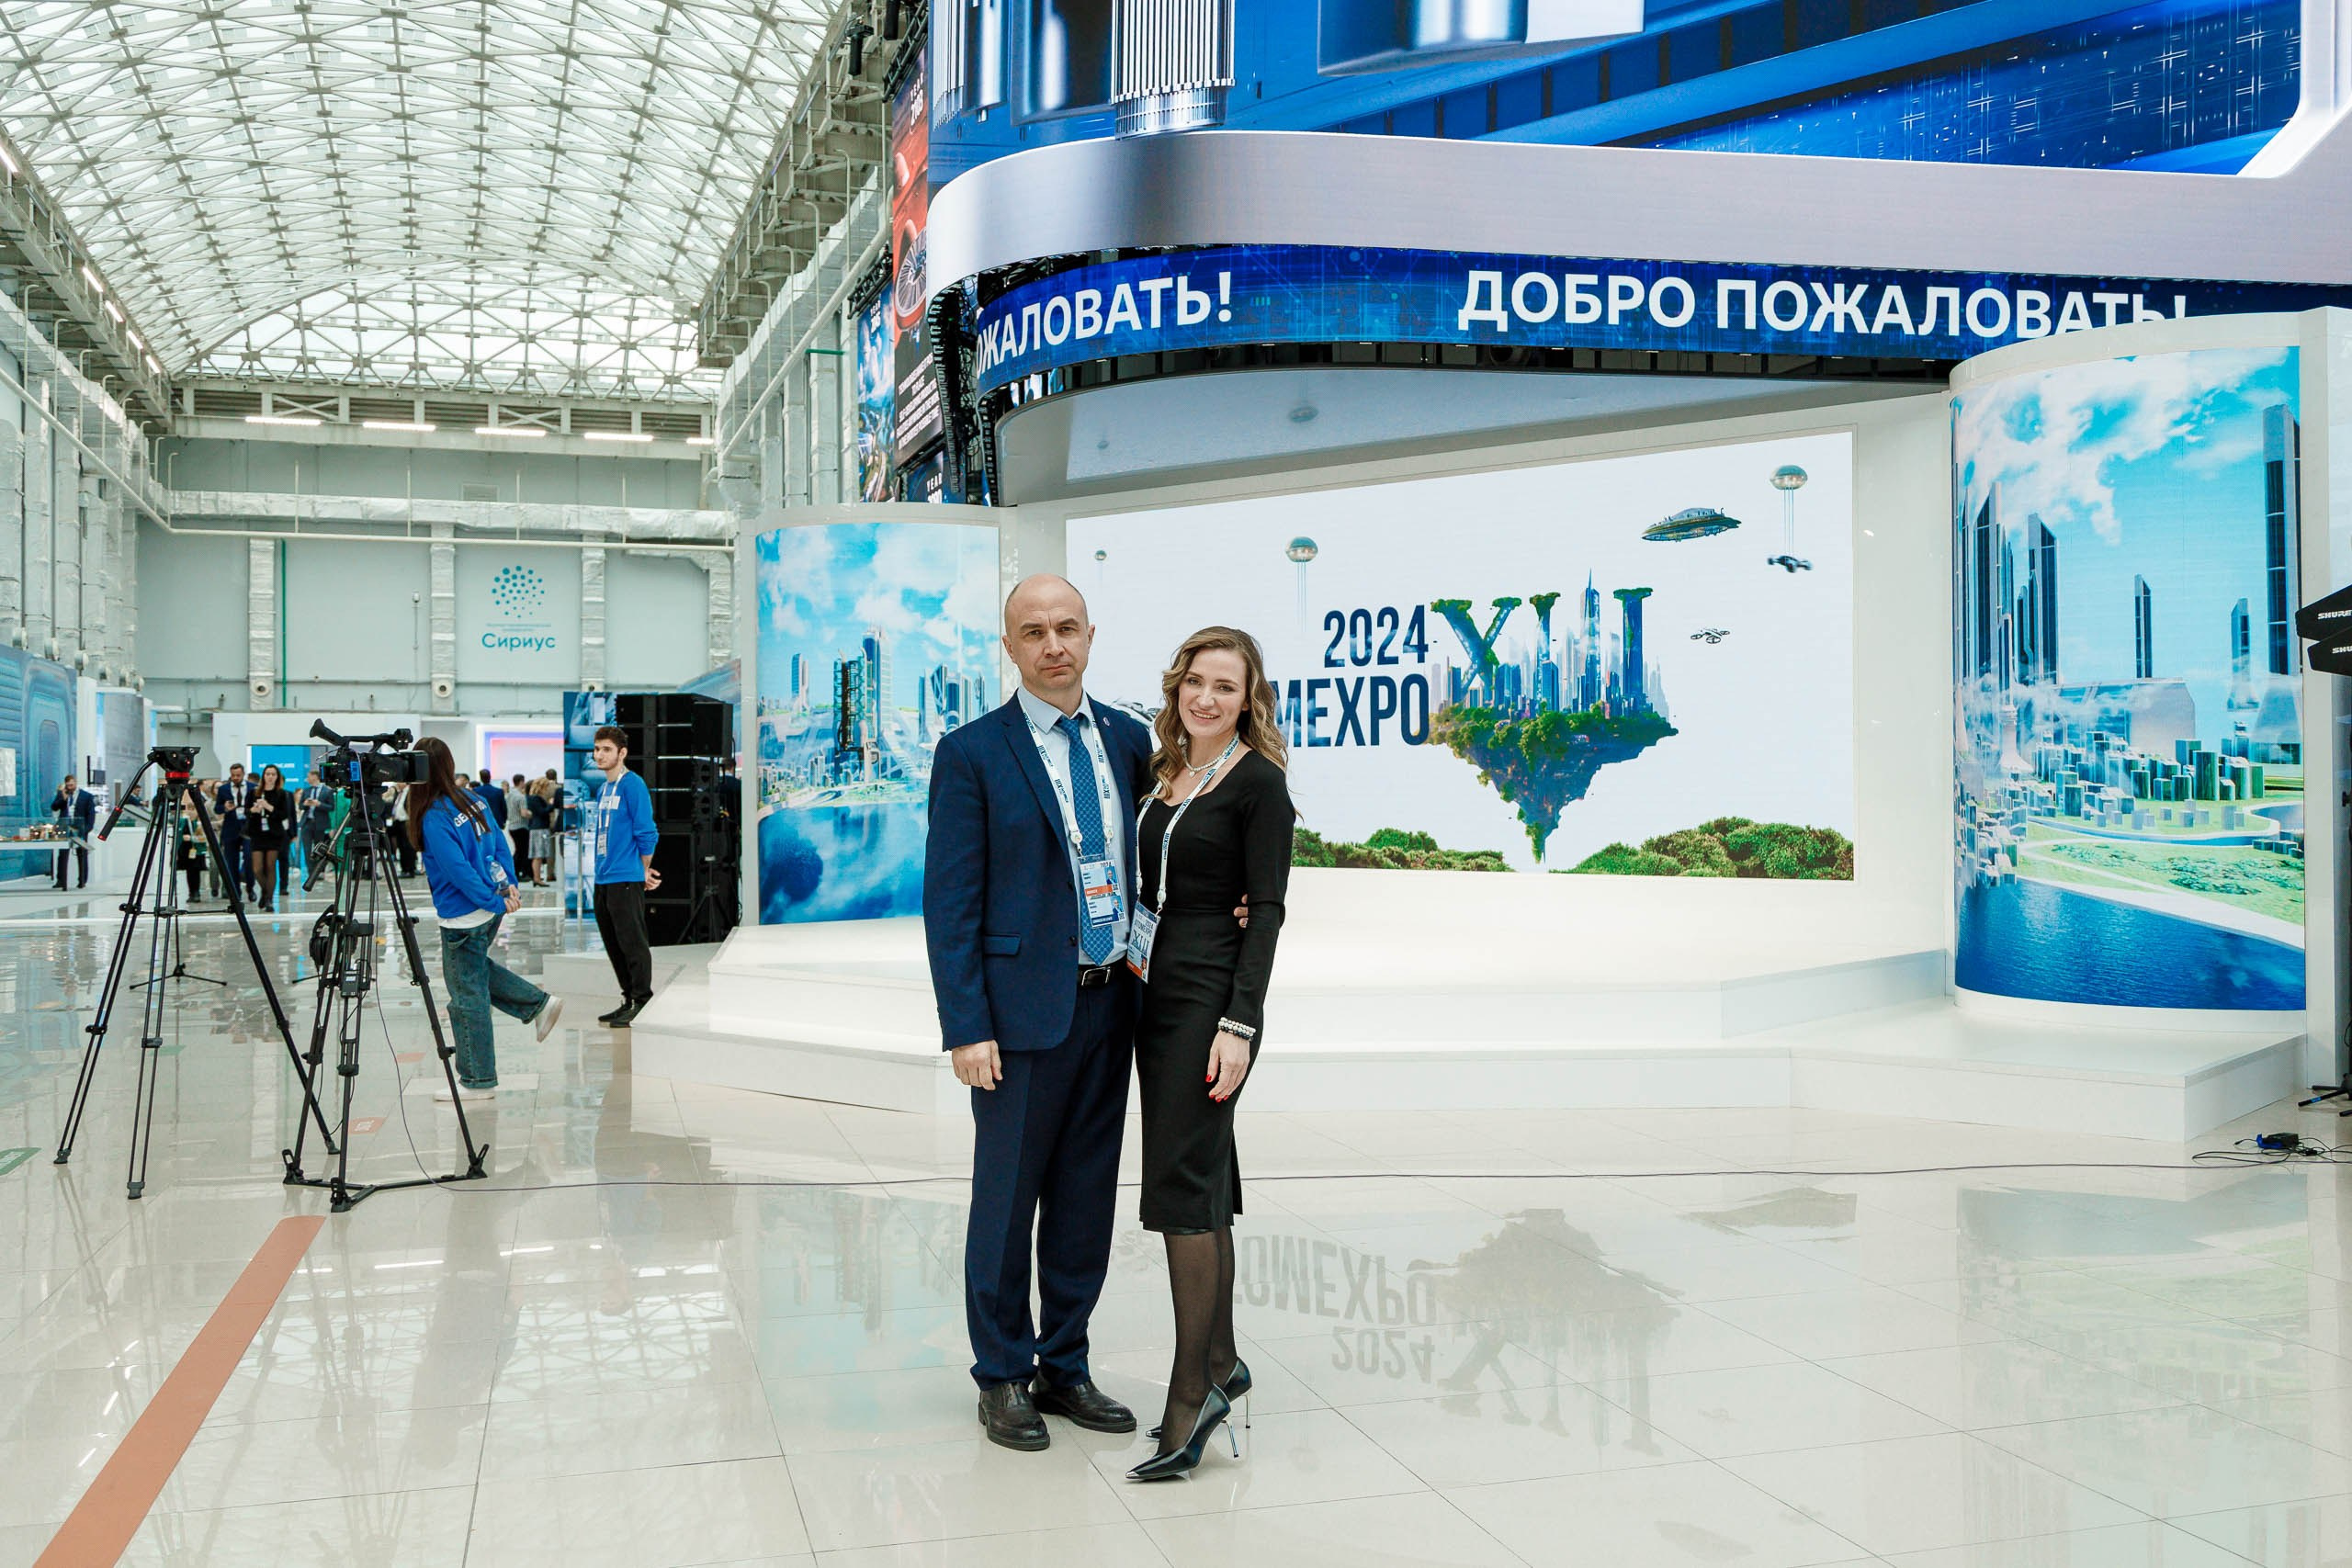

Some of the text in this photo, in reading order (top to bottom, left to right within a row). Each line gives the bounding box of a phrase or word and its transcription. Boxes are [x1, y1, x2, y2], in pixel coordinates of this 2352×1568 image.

[977, 271, 1232, 378] ОЖАЛОВАТЬ!
[1458, 270, 1696, 332] ДОБРО
[481, 632, 556, 651] Сириус
[1323, 604, 1429, 668] 2024
[2317, 609, 2352, 619] SHURE
[2332, 645, 2352, 654] SHU
[1266, 673, 1430, 748] MEXPO
